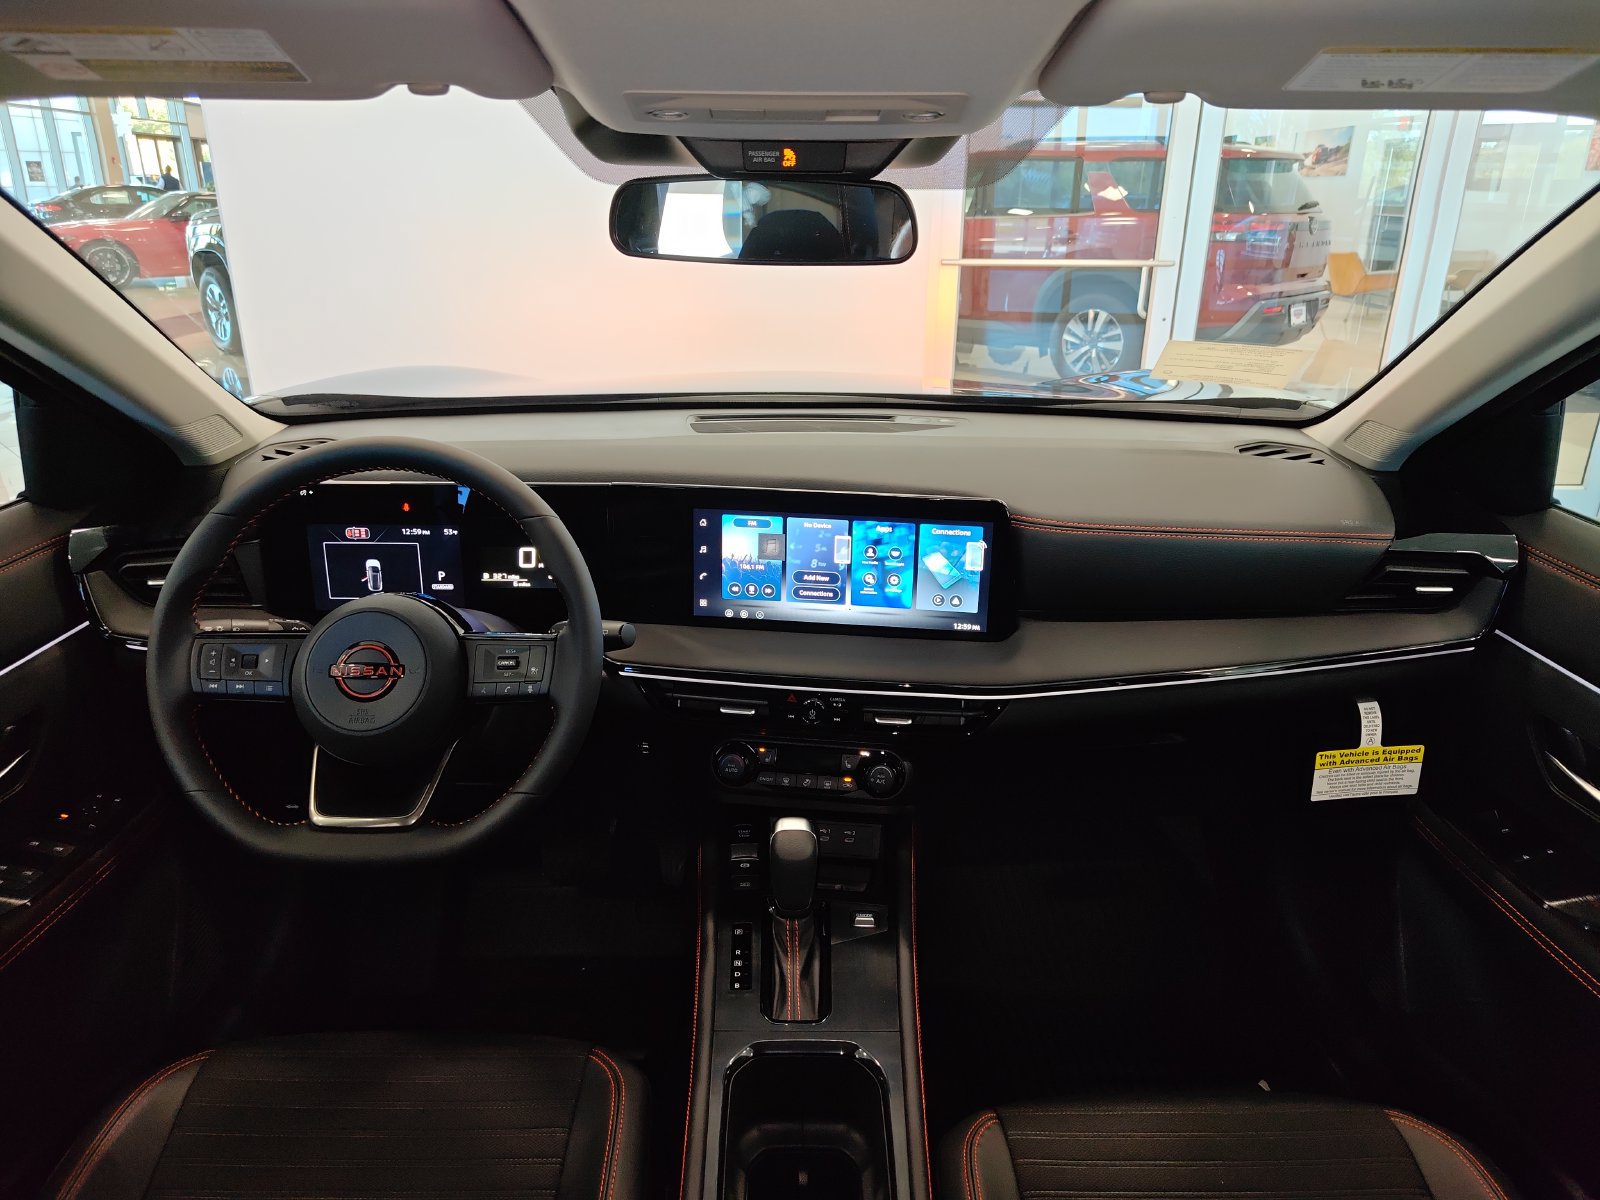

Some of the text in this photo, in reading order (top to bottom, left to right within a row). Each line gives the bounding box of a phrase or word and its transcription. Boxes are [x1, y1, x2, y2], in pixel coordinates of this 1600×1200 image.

[932, 528, 972, 536] Connections
[518, 547, 536, 568] 0
[438, 570, 446, 581] P
[799, 590, 834, 598] Connections
[330, 664, 403, 677] NISSAN
[1382, 748, 1421, 756] Equipped
[1340, 757, 1380, 765] Advanced
[1398, 754, 1418, 762] Bags
